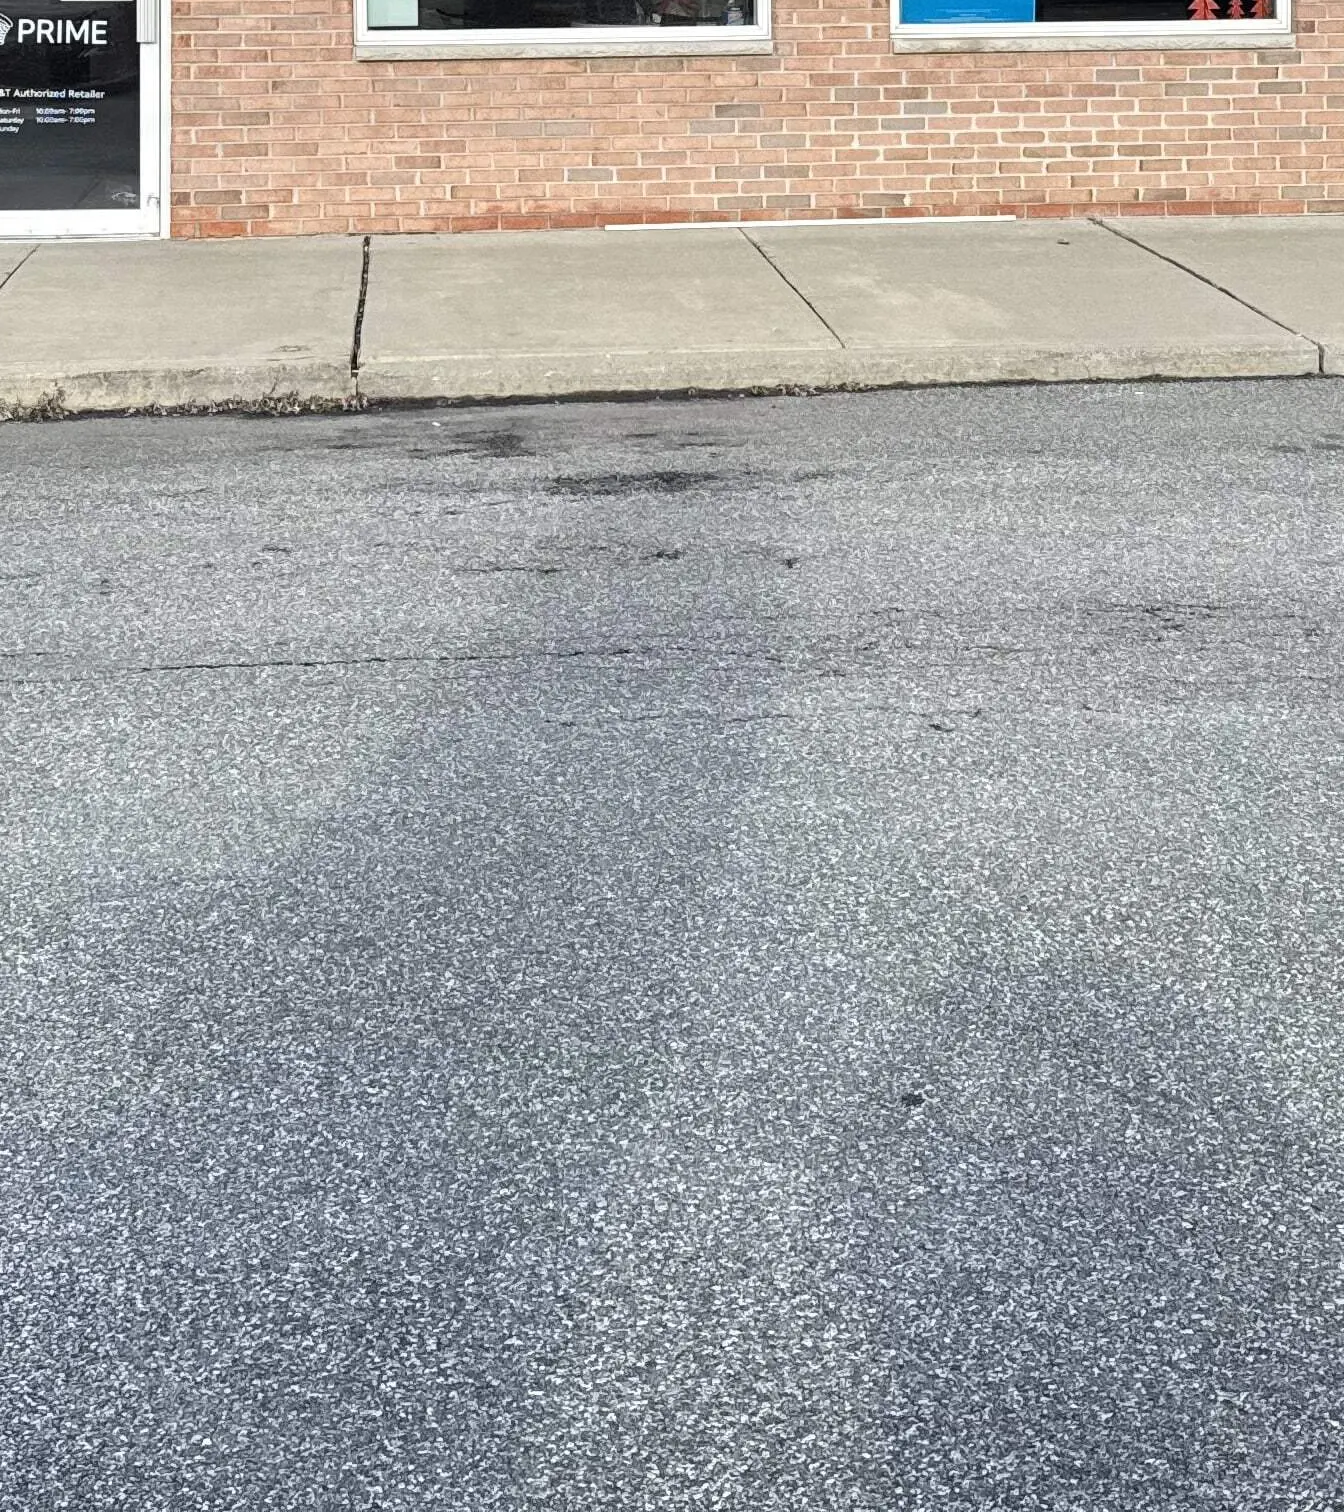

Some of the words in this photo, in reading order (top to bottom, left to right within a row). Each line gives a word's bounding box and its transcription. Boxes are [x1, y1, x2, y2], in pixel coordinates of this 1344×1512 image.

[17, 18, 108, 45] PRIME
[13, 88, 66, 98] Authorized
[68, 89, 106, 99] Retailer
